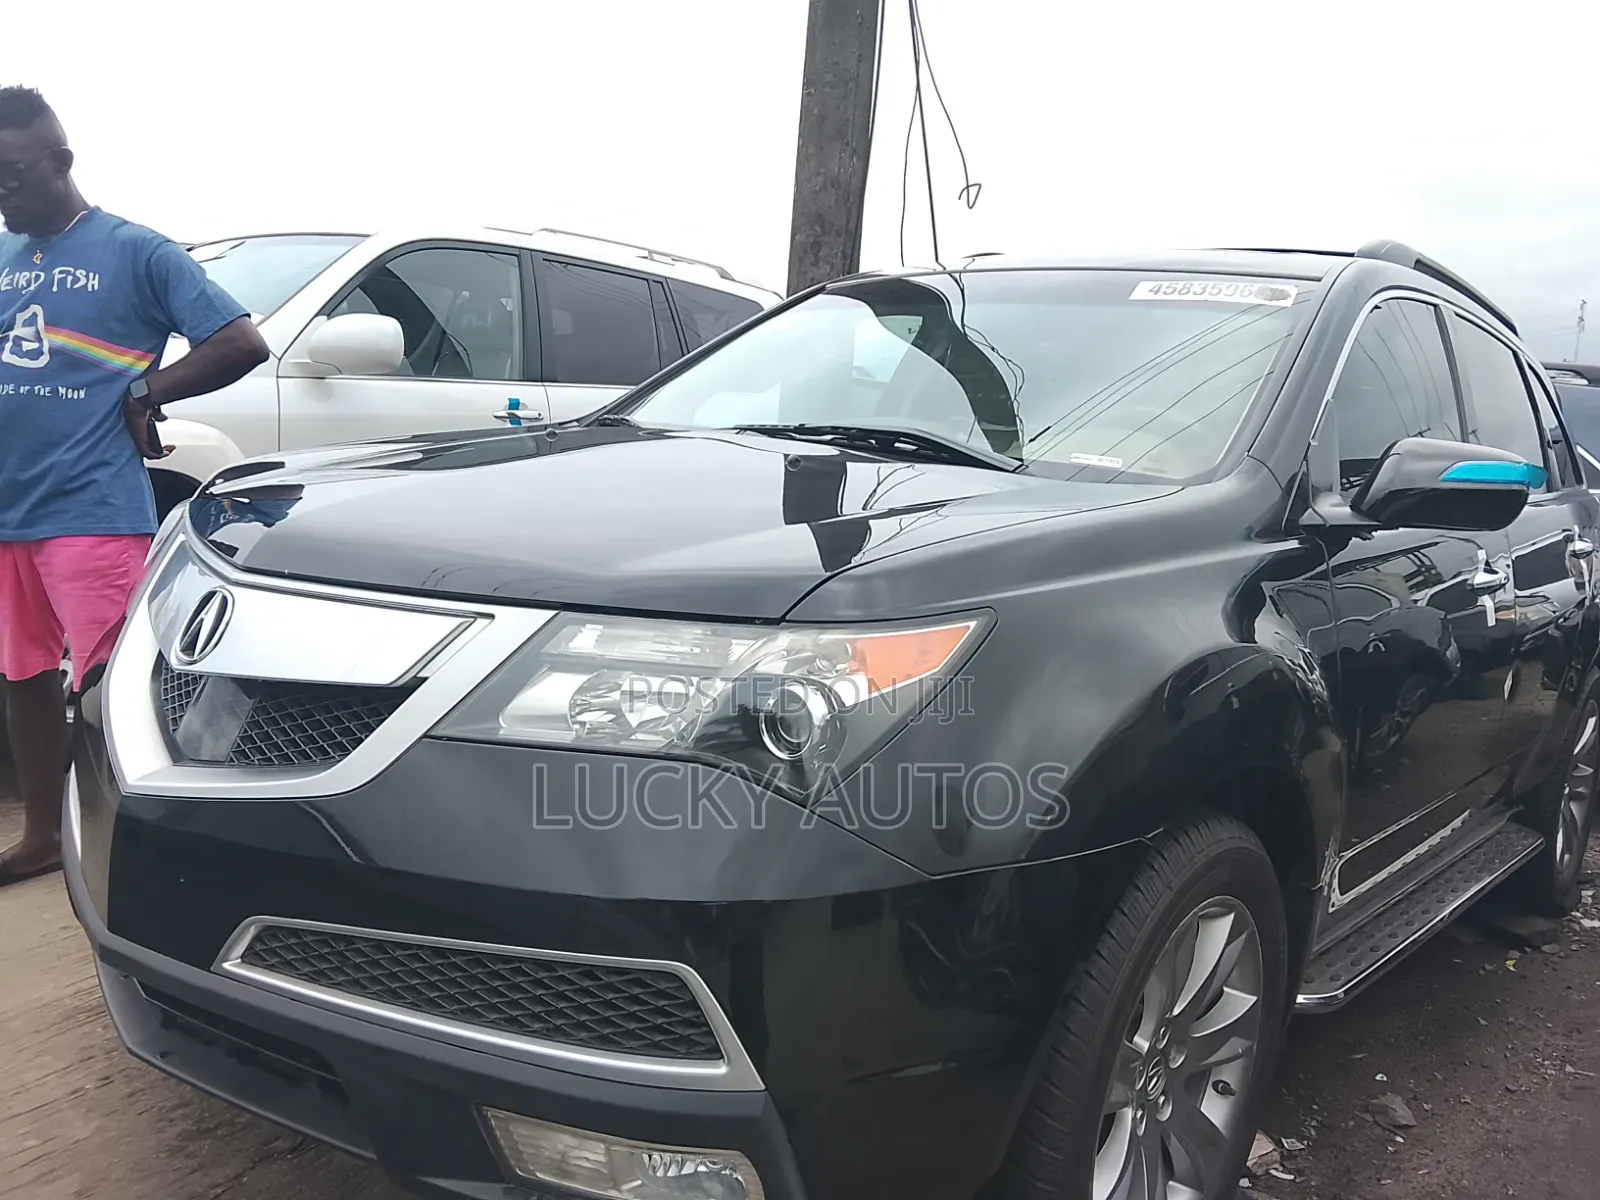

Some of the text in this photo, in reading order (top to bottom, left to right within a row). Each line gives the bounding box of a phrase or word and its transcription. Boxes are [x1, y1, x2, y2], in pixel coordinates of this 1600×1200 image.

[1148, 281, 1269, 299] 4583596
[20, 385, 31, 395] OF
[34, 385, 53, 396] THE
[58, 385, 87, 400] MOON
